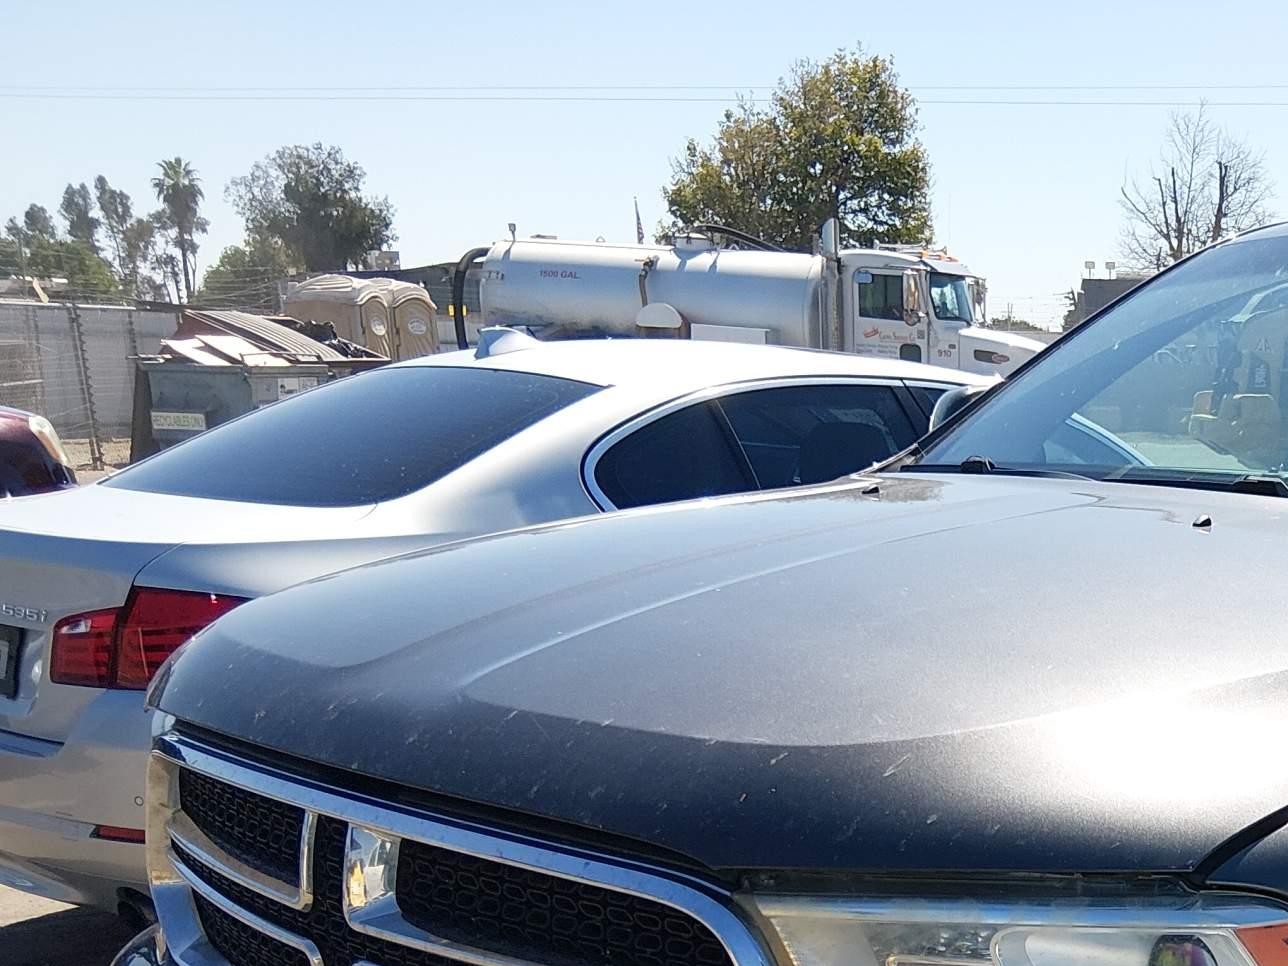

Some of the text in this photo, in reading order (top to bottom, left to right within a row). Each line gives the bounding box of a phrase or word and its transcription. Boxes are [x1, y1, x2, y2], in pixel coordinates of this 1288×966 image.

[540, 270, 558, 278] 1500
[937, 349, 952, 358] 910
[2, 603, 48, 623] 535i
